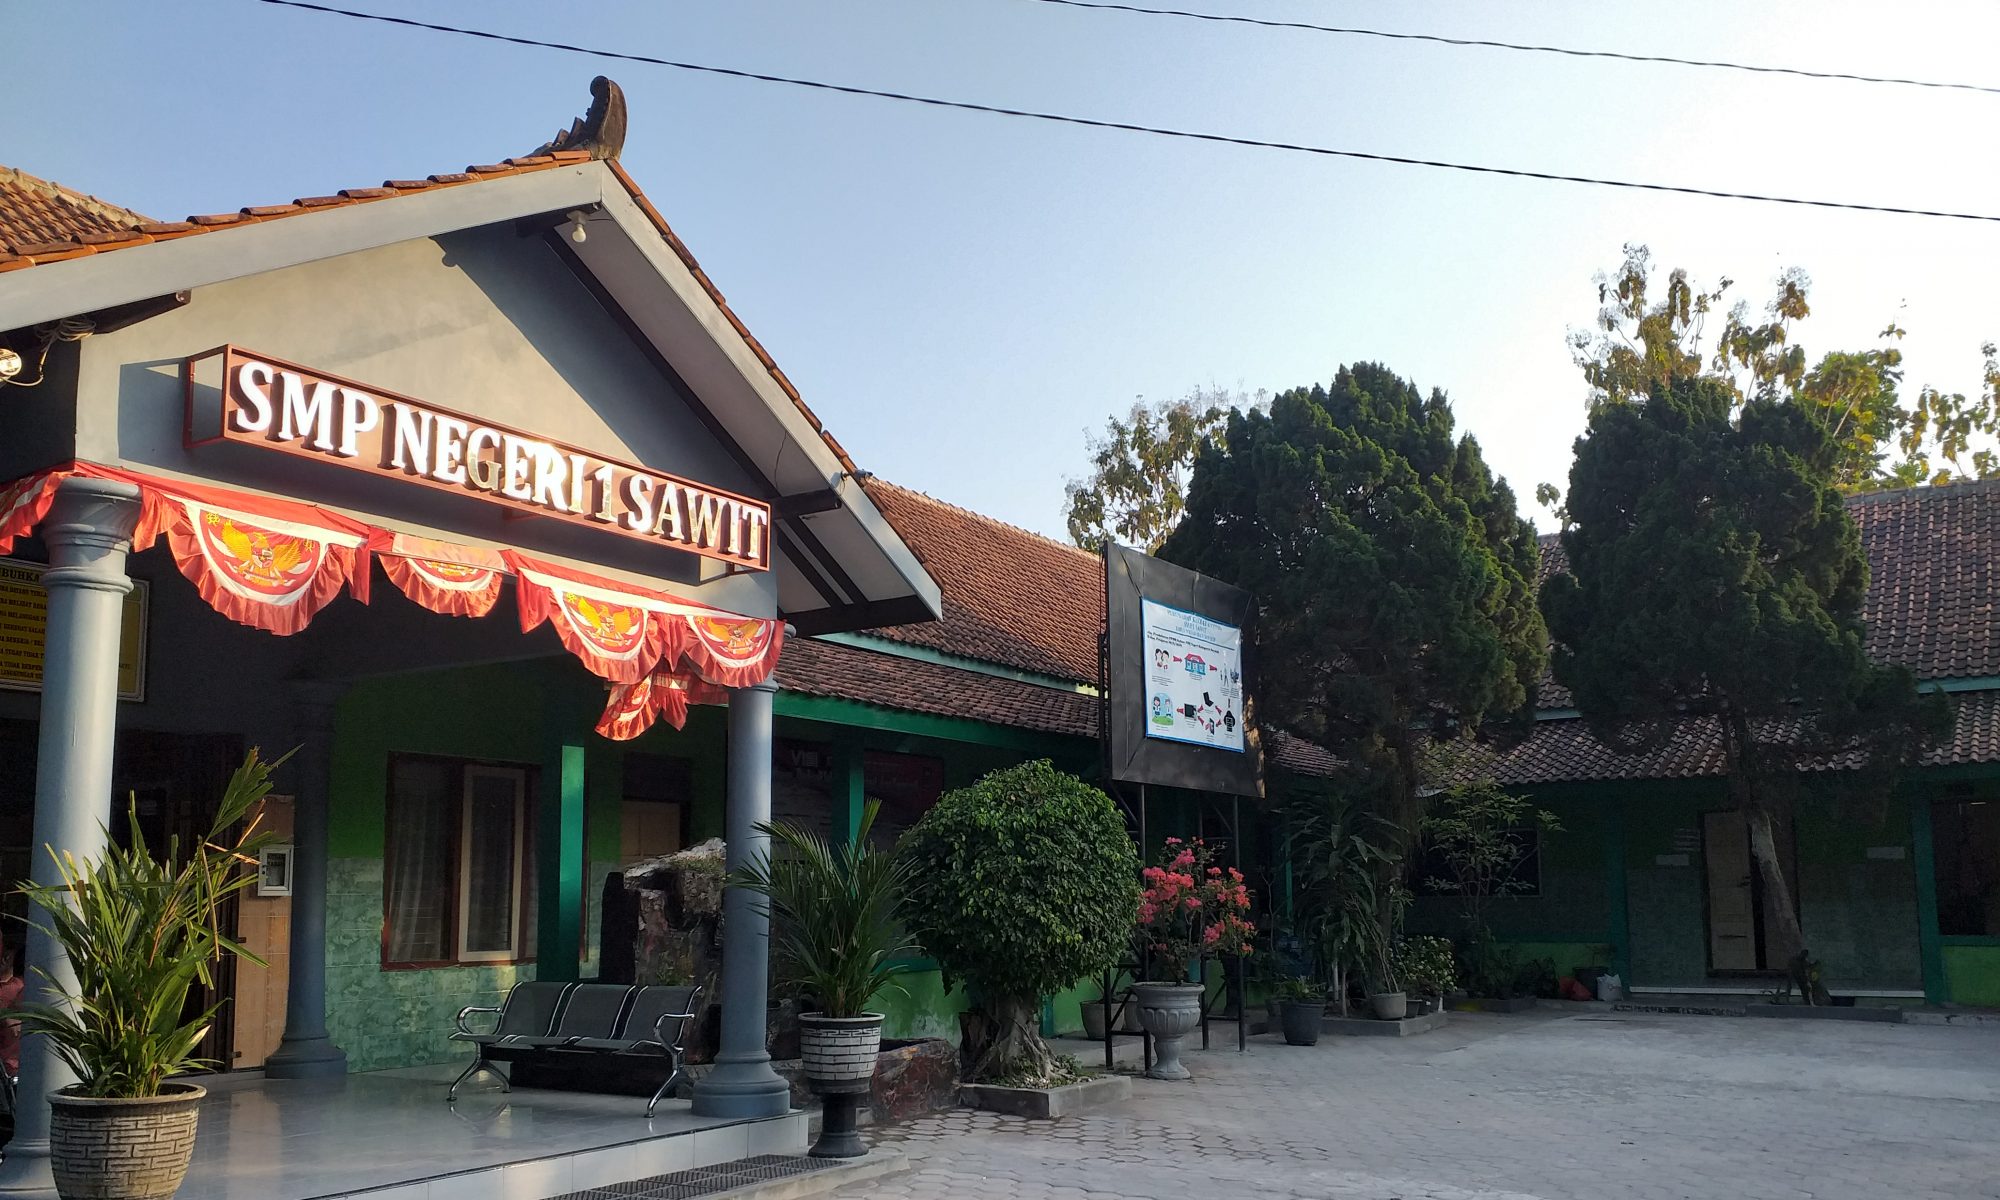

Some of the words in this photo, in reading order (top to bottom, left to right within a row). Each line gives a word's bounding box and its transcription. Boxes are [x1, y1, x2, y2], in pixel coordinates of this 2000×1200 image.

[237, 362, 379, 457] SMP
[391, 402, 587, 514] NEGERI
[594, 464, 619, 523] 1
[627, 473, 767, 559] SAWIT
